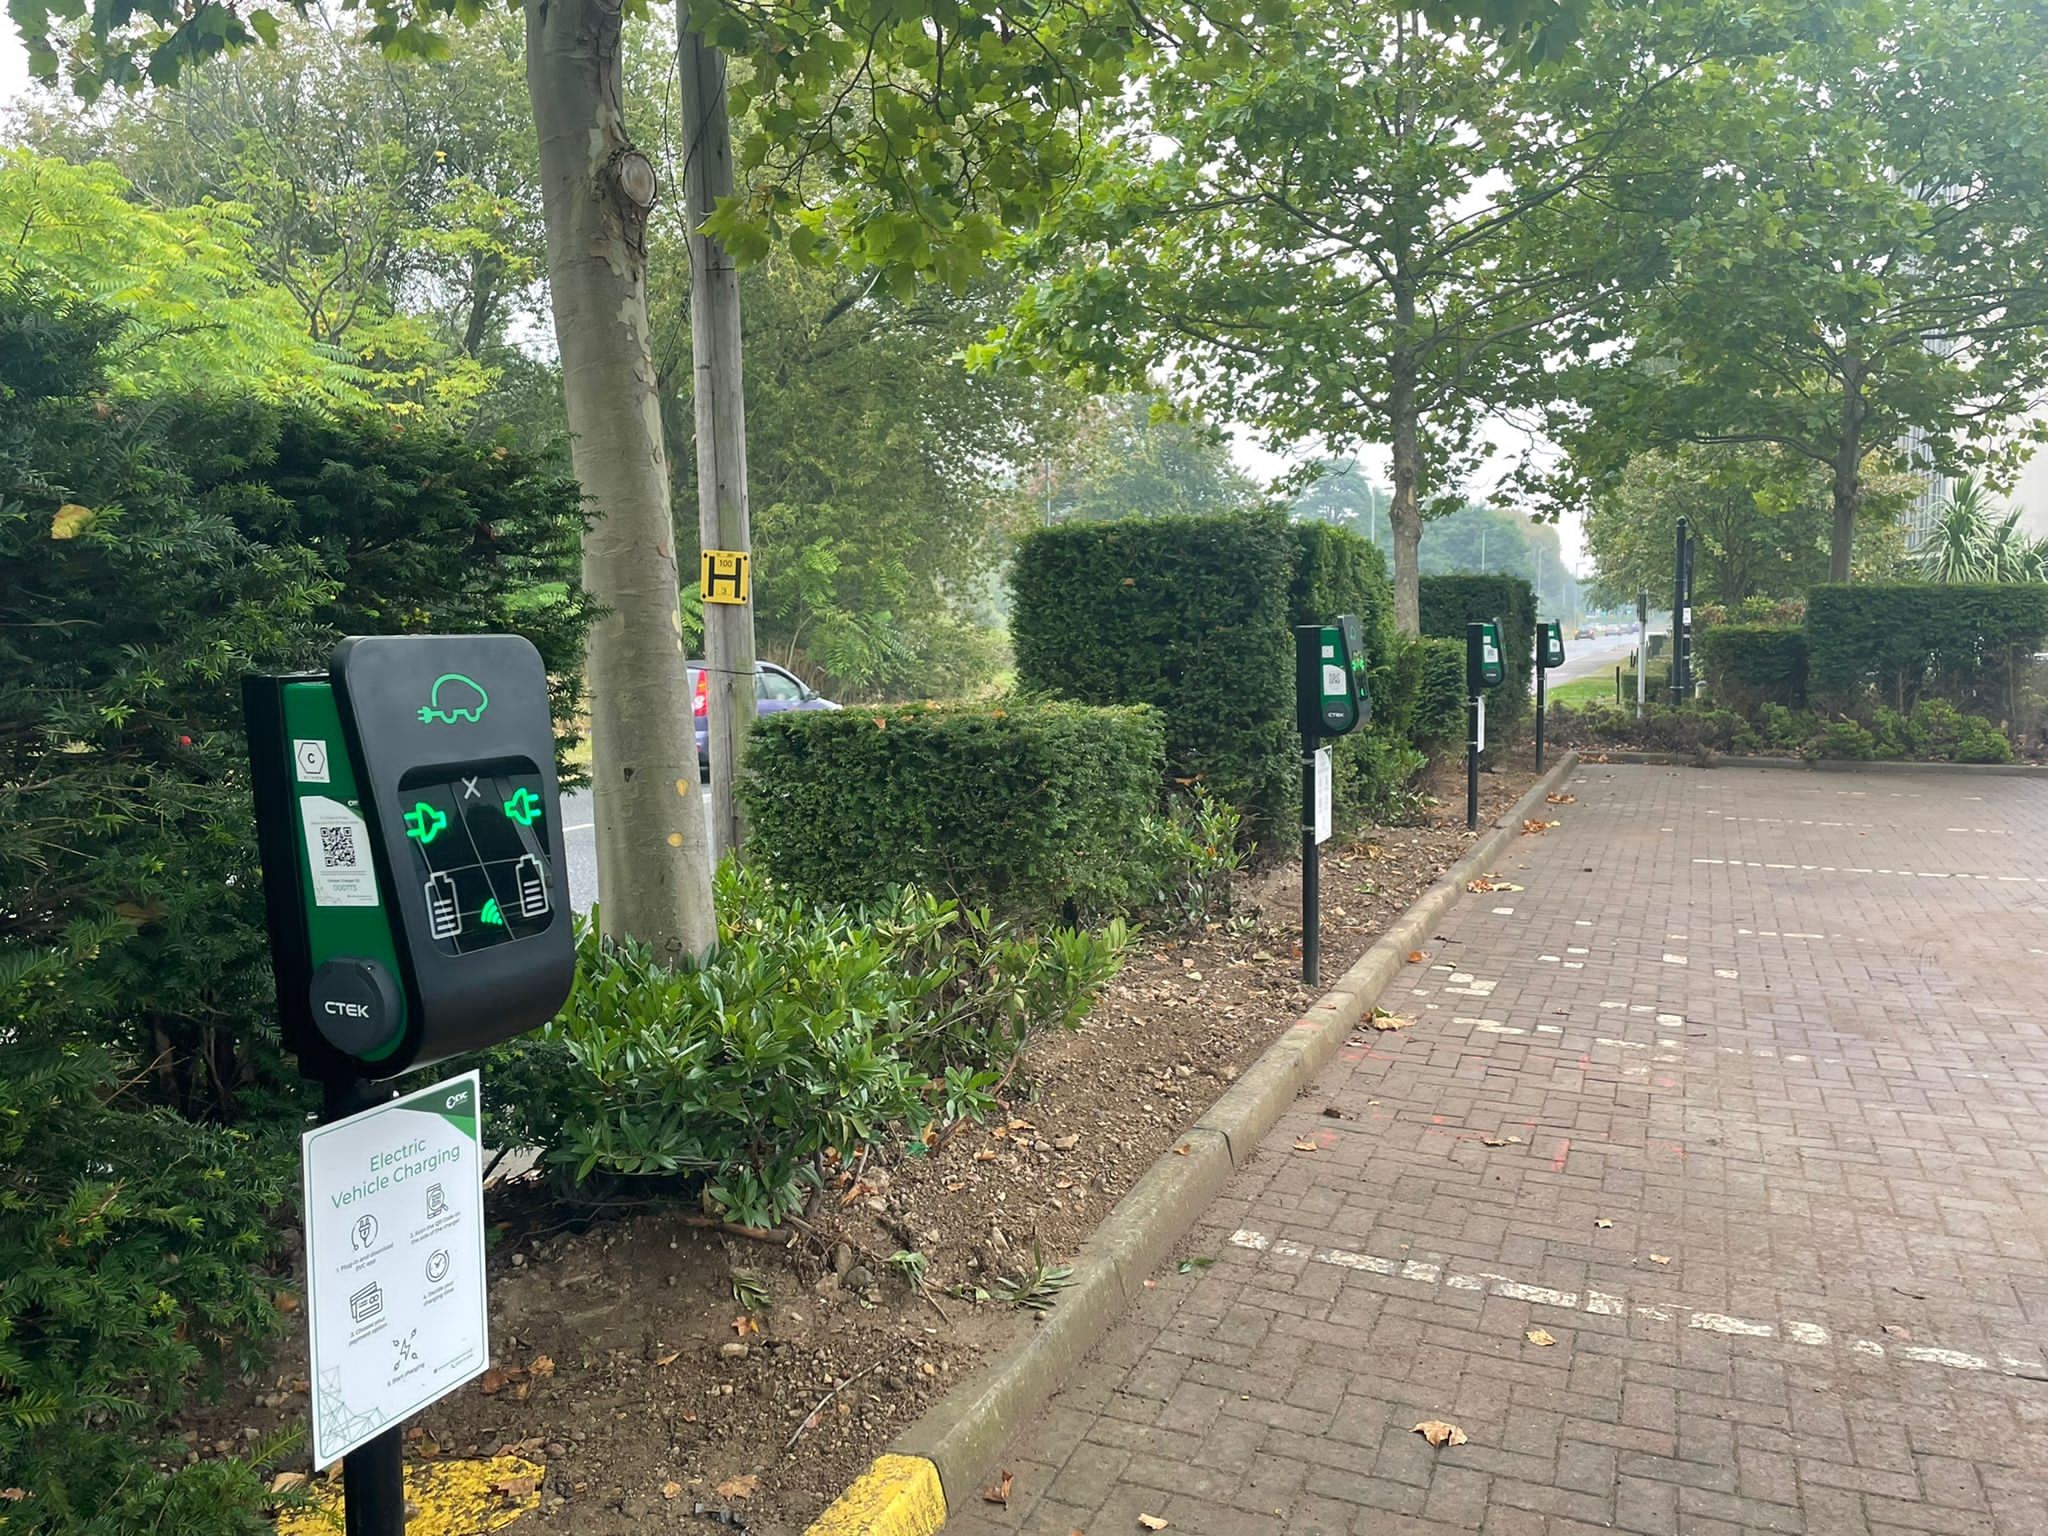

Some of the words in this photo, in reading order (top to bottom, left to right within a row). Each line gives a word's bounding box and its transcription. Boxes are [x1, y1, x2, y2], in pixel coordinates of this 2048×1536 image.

[719, 559, 733, 568] 100
[708, 555, 742, 598] H
[307, 752, 316, 764] C
[324, 1001, 369, 1018] CTEK
[370, 1138, 427, 1172] Electric
[331, 1175, 389, 1209] Vehicle
[393, 1145, 461, 1183] Charging
